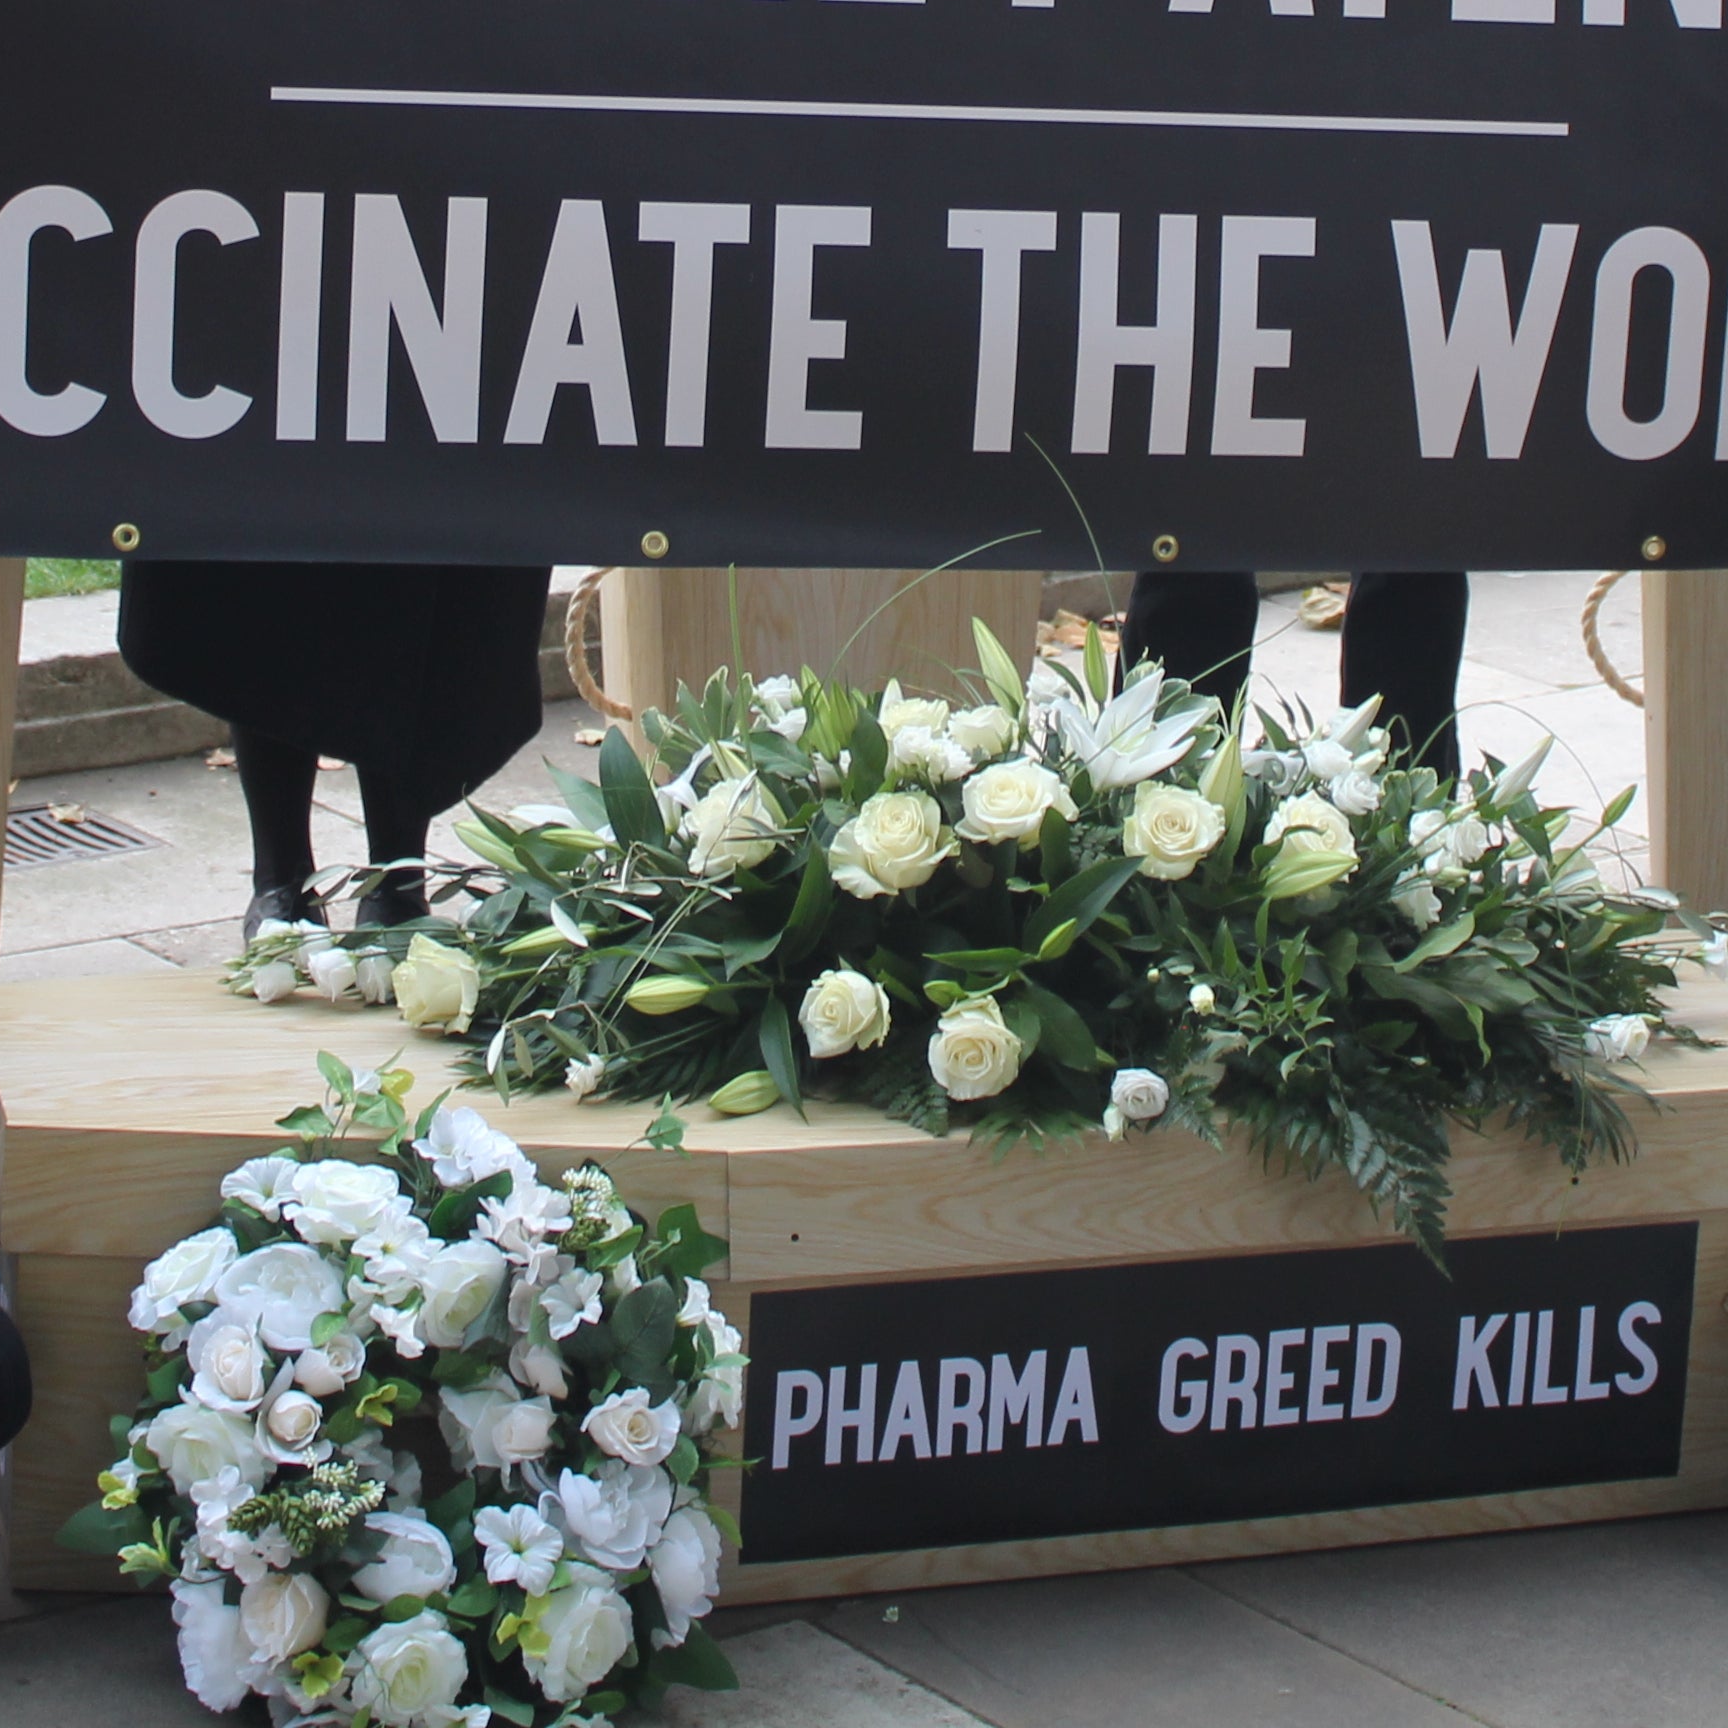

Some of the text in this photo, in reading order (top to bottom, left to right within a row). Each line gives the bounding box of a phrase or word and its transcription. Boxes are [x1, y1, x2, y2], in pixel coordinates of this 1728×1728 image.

[948, 209, 1317, 456] THE
[772, 1301, 1663, 1470] PHARMA GREED KILLS
